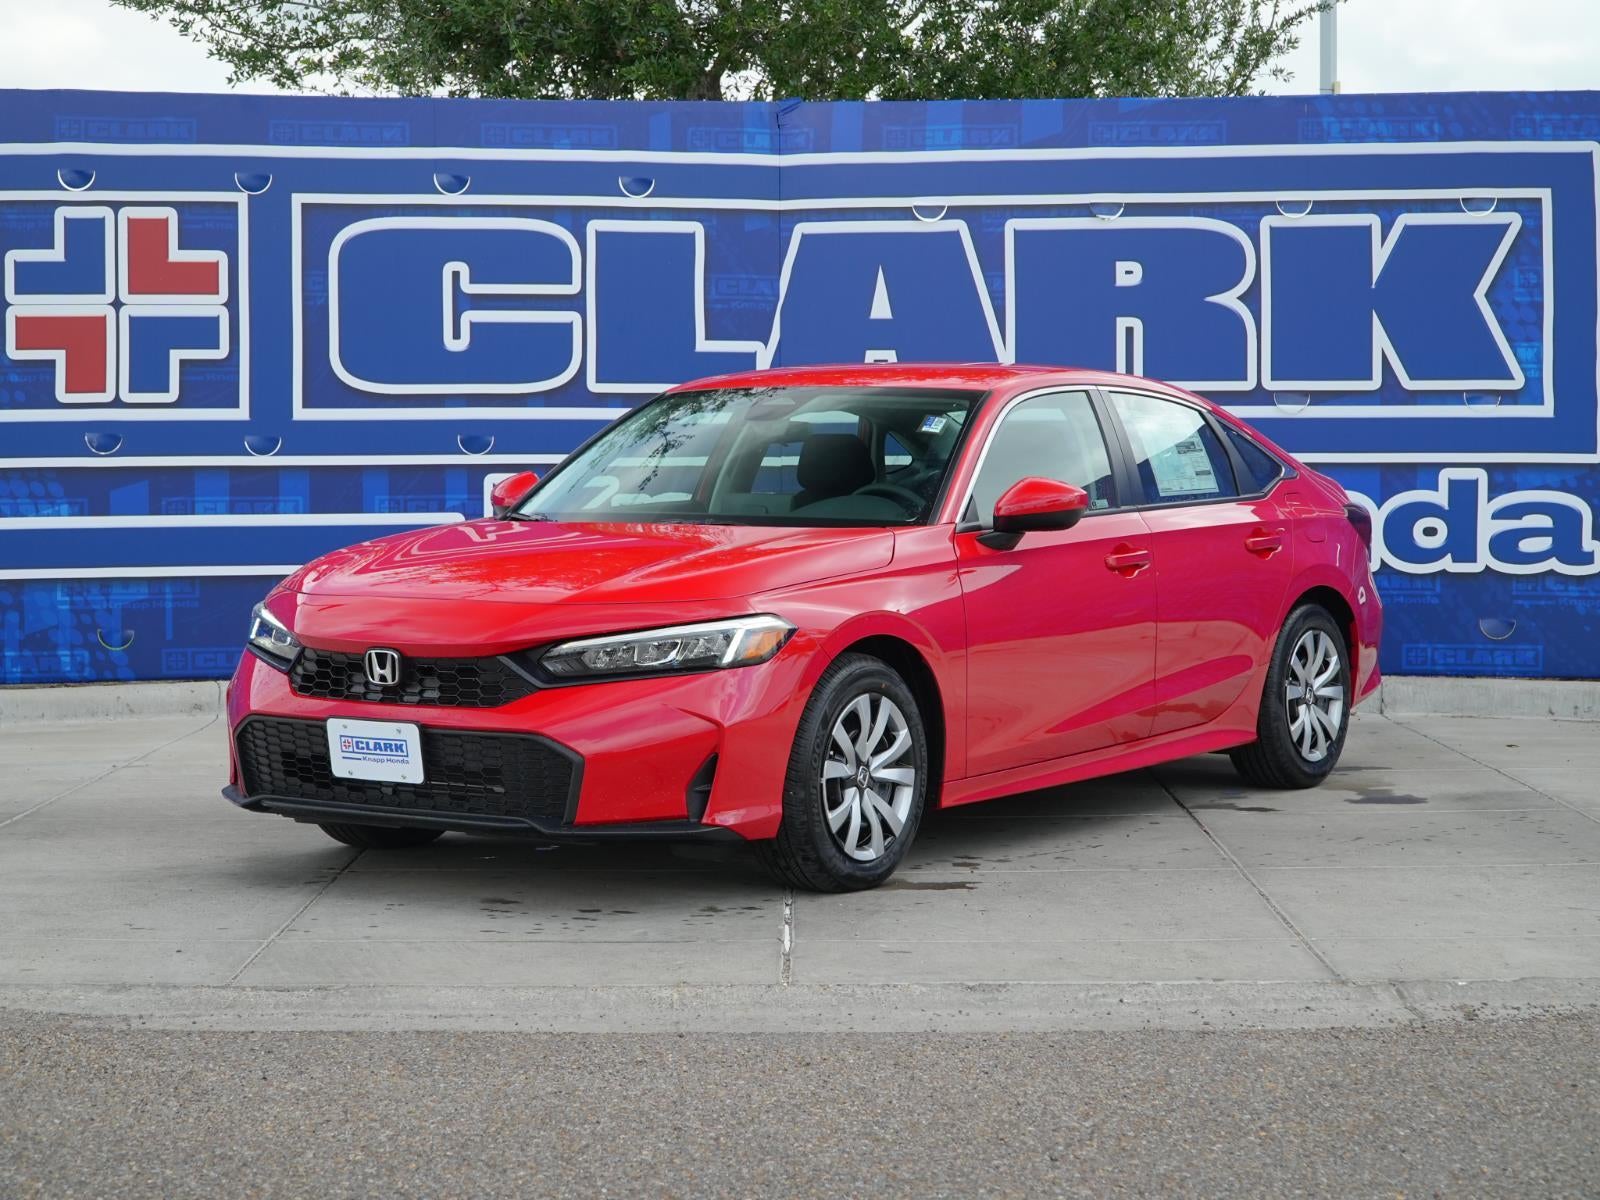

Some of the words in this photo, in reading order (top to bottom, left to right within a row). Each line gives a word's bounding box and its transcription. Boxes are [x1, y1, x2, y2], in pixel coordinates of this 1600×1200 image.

[328, 212, 1527, 393] CLARK
[1434, 649, 1537, 665] CLARK
[355, 740, 405, 753] CLARK
[362, 756, 386, 764] Knapp
[386, 757, 410, 765] Honda
